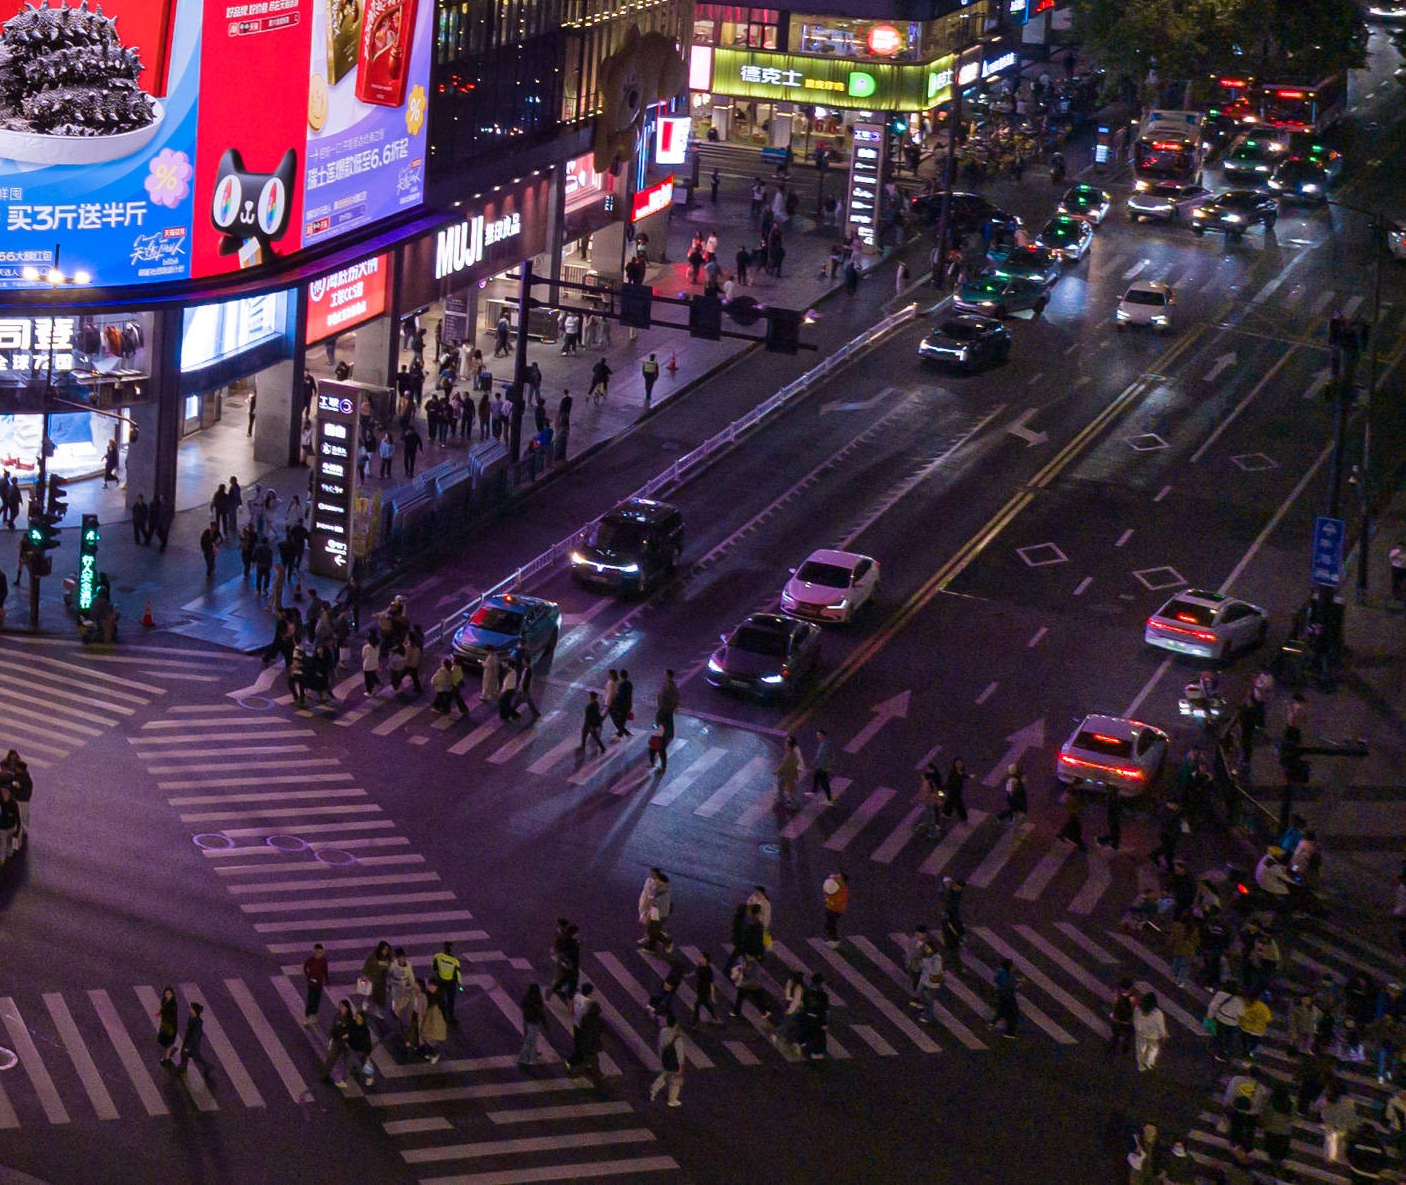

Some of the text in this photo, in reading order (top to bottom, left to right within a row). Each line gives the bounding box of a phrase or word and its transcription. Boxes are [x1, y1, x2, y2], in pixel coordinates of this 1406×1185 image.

[740, 65, 803, 87] 德克士
[8, 201, 147, 231] 买3斤送半斤
[436, 213, 520, 279] MUJI 無印良品
